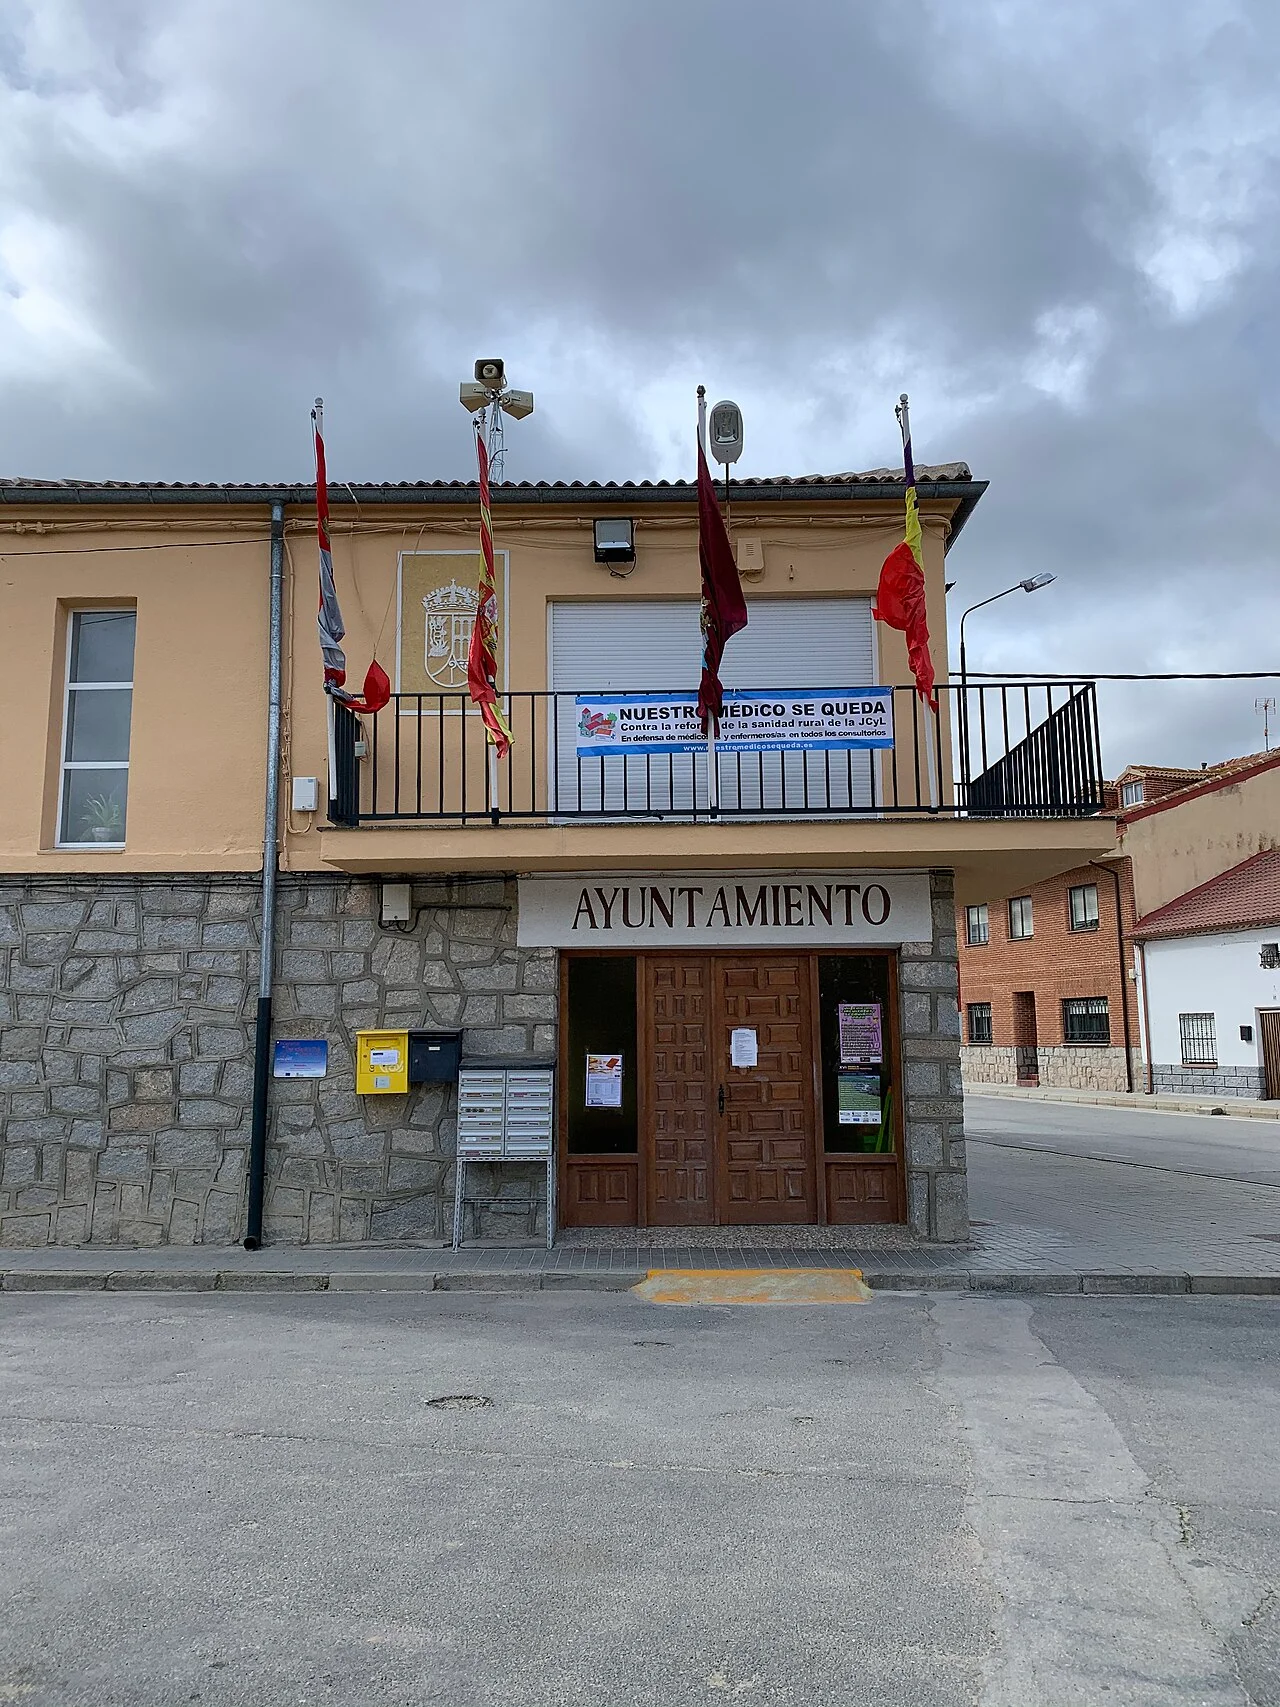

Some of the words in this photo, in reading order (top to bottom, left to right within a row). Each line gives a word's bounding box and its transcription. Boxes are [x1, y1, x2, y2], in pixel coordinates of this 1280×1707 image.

[620, 705, 703, 720] NUESTR
[792, 704, 815, 716] SE
[821, 701, 886, 716] QUEDA
[621, 722, 658, 731] Contra
[662, 722, 671, 730] la
[721, 721, 735, 730] de
[739, 719, 748, 729] la
[751, 719, 795, 728] sanidad
[798, 718, 825, 727] rural
[828, 718, 841, 727] de
[845, 717, 854, 726] la
[858, 717, 886, 727] JCyL
[633, 734, 665, 742] defensa
[801, 730, 824, 738] todos
[825, 729, 836, 737] los
[838, 729, 886, 737] consultorios
[572, 884, 891, 929] AYUNTAMIENTO
